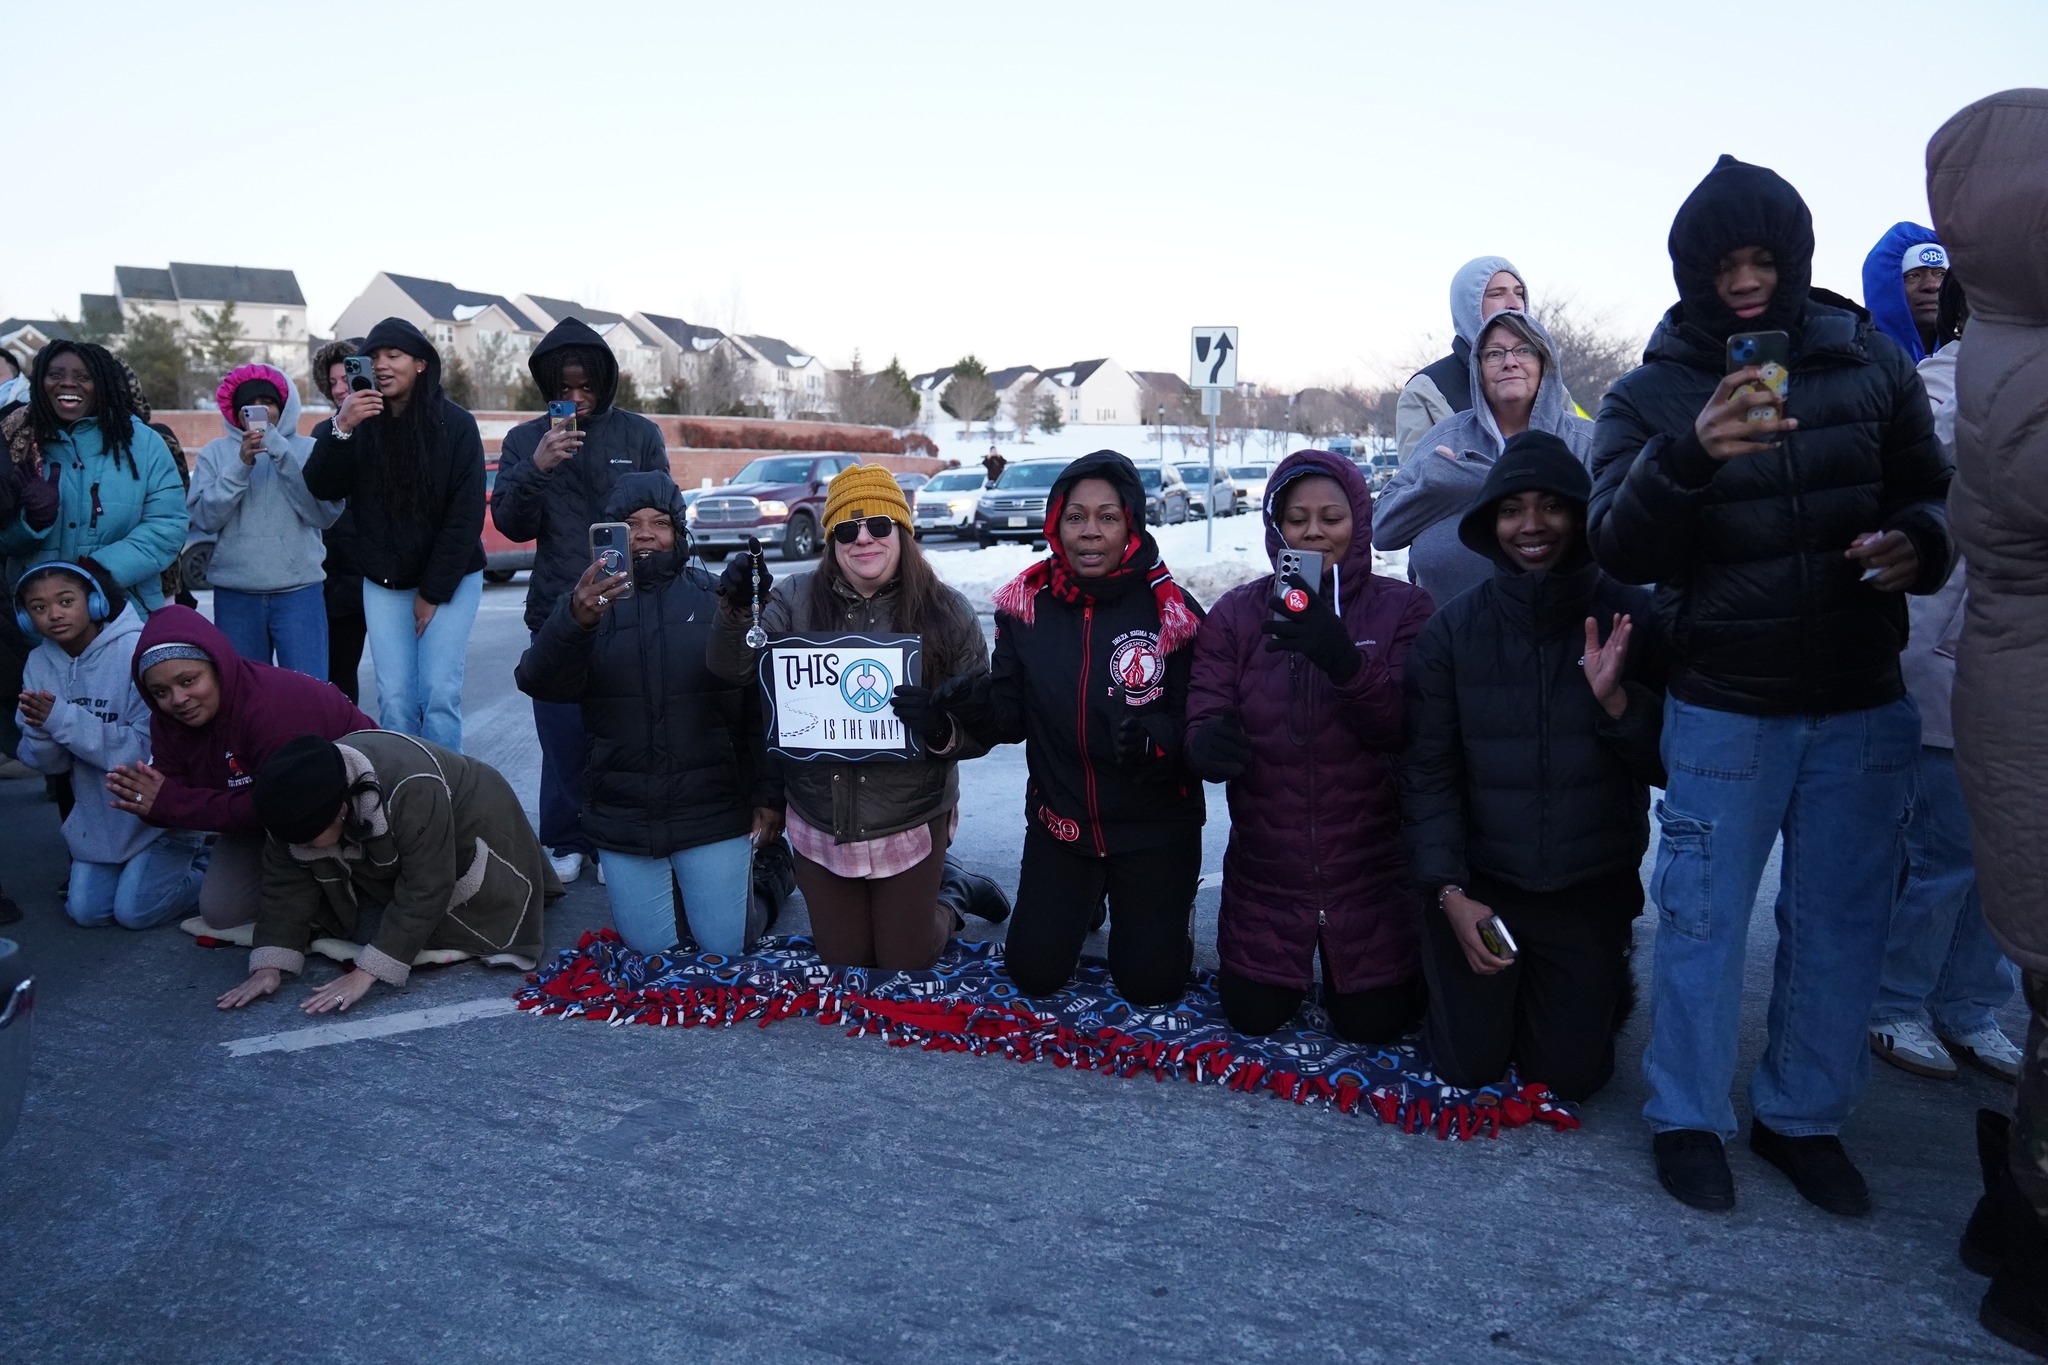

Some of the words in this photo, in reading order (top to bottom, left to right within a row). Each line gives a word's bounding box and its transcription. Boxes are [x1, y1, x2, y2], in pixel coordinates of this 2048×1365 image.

[1112, 634, 1129, 646] DELTA
[1115, 641, 1148, 659] LEADERSHIP
[778, 653, 840, 690] THIS
[1112, 660, 1124, 684] SERVICE
[824, 718, 836, 740] IS
[842, 718, 863, 740] THE
[869, 718, 900, 740] WAY!
